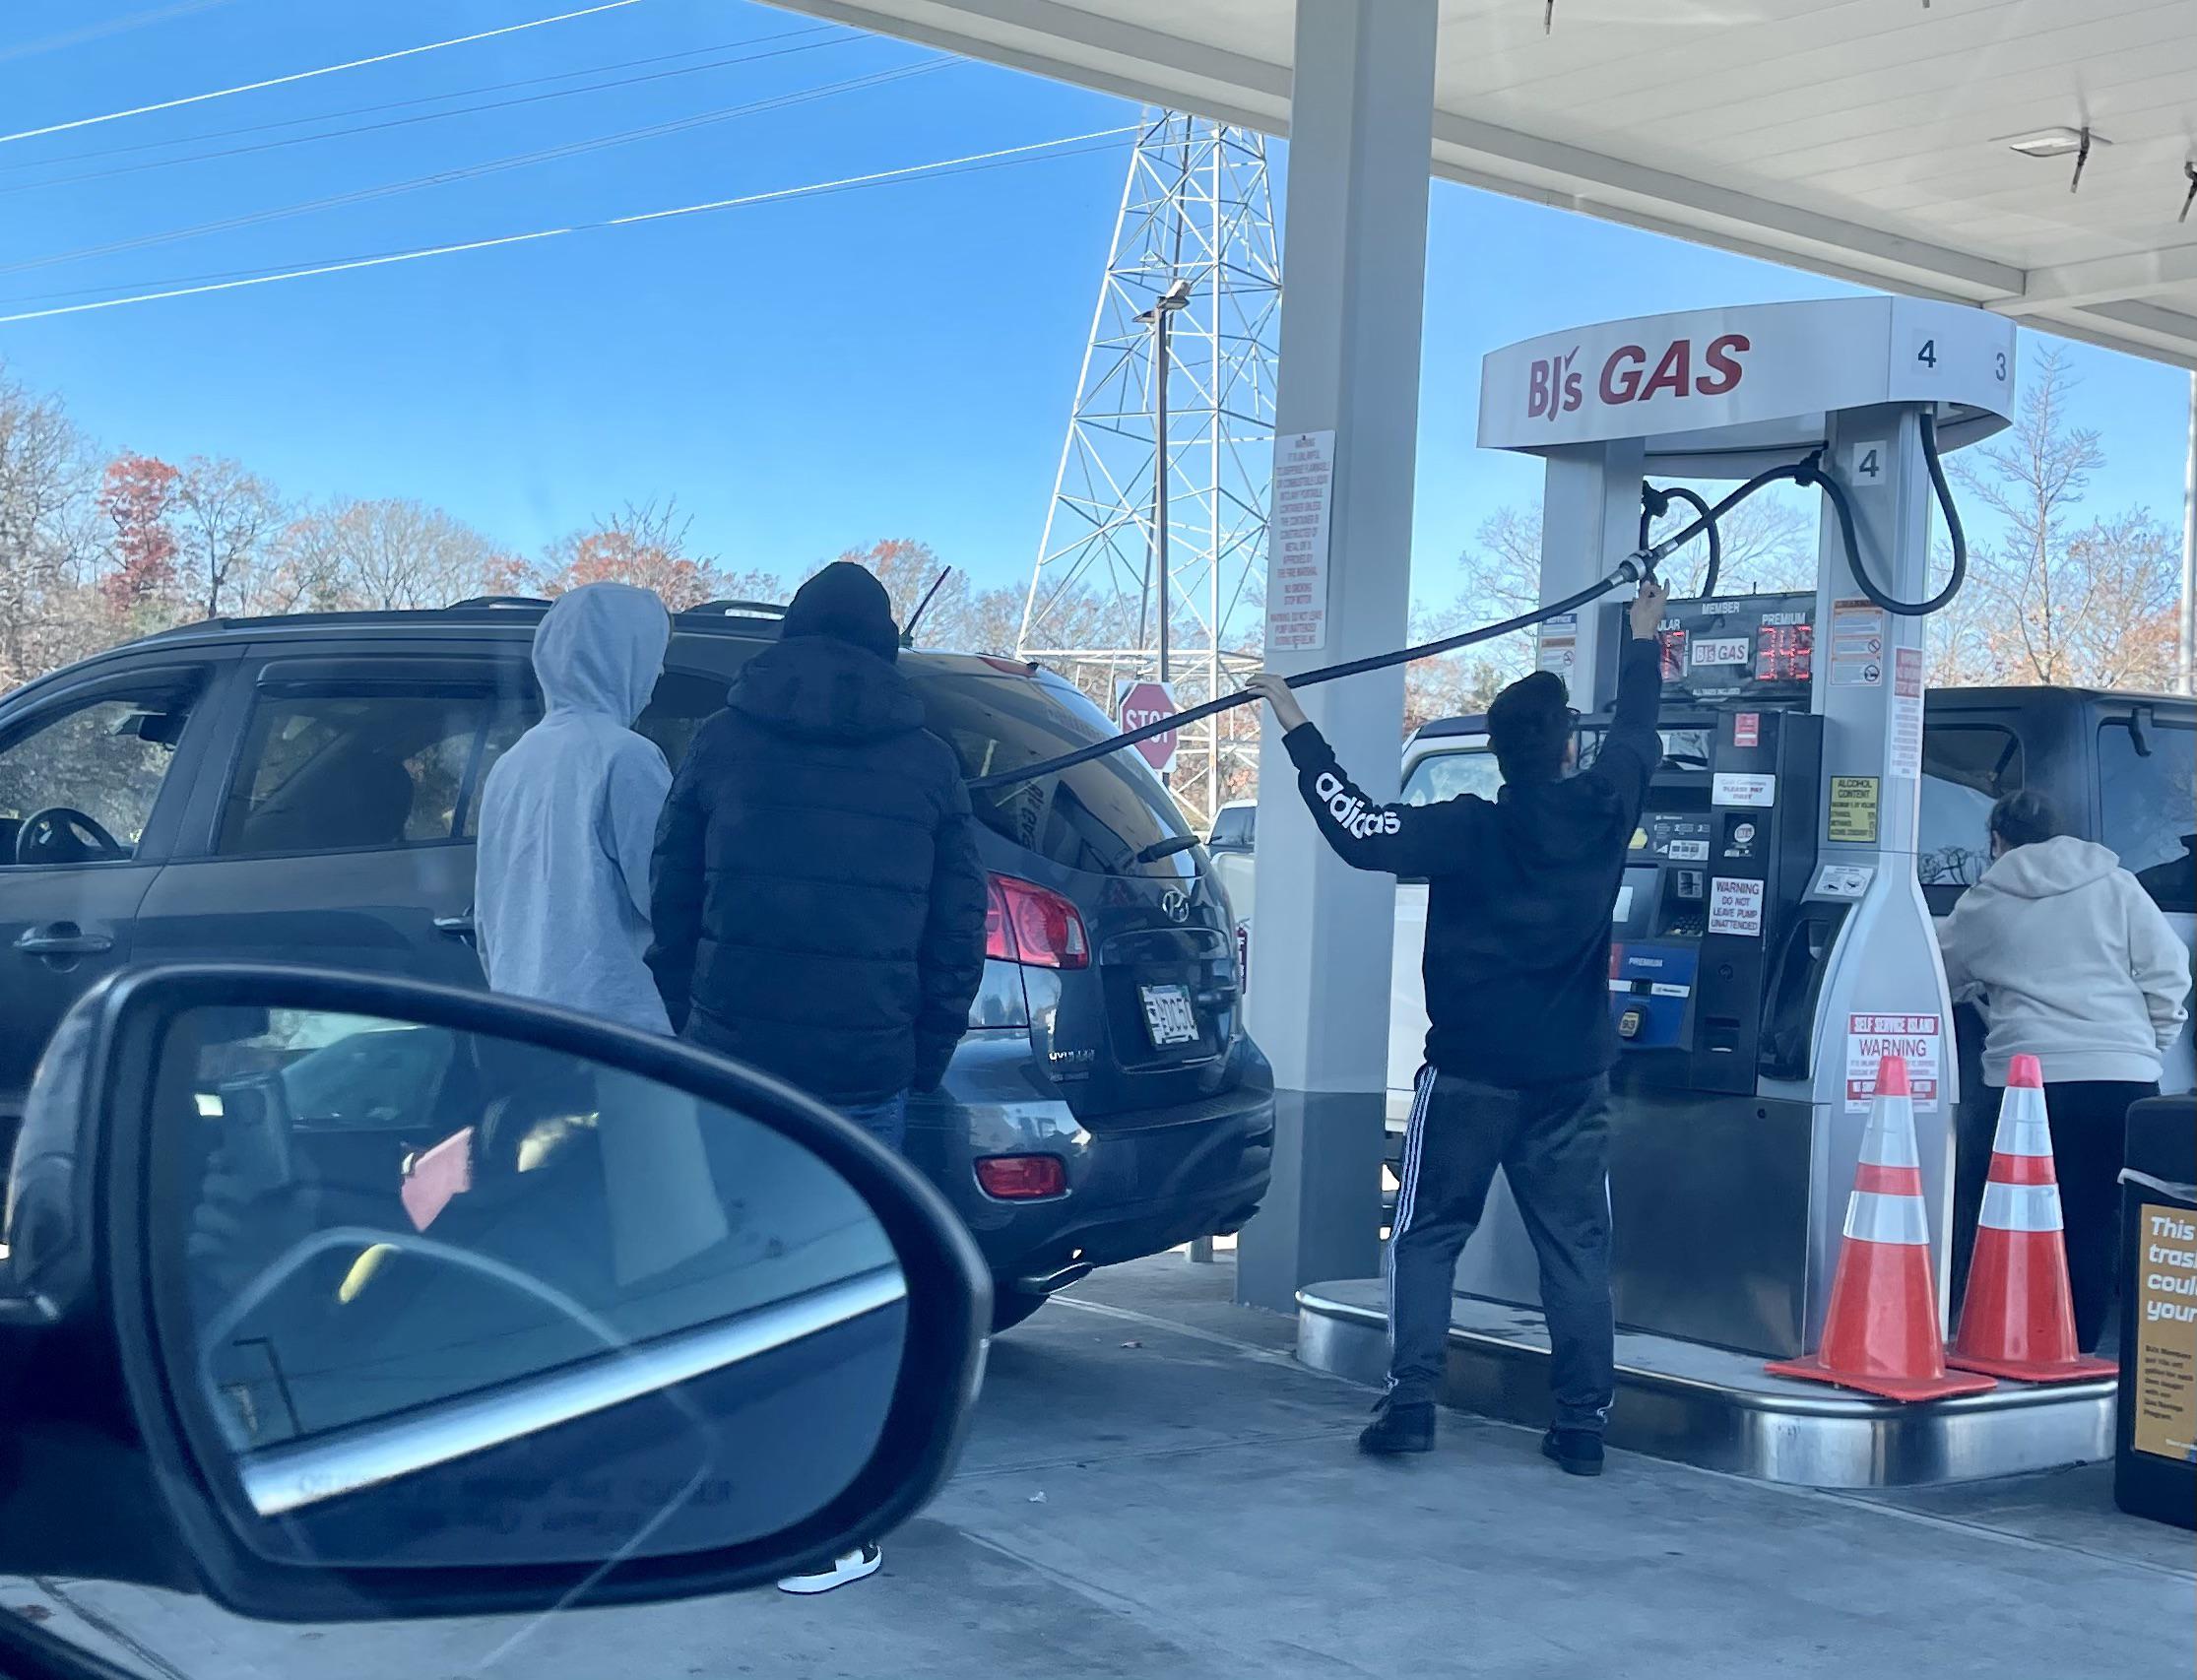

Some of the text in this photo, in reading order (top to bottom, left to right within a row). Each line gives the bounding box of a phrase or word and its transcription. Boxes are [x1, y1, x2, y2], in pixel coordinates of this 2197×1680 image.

[1918, 340, 1937, 368] 4
[1599, 334, 1751, 405] GAS
[1996, 353, 2007, 381] 3
[1859, 449, 1879, 478] 4
[1702, 602, 1741, 615] MEMBER
[1762, 613, 1806, 625] PREMIUM
[1718, 645, 1746, 661] GAS
[1126, 709, 1175, 743] STOP
[1838, 779, 1872, 789] ALCOHOL
[1838, 789, 1870, 799] CONTENT
[1316, 772, 1401, 839] adidas
[1716, 881, 1760, 895] WARNING
[1722, 896, 1751, 906] DO NOT
[1712, 907, 1758, 919] LEAVE PUMP
[1711, 919, 1758, 931] UNATTENDED
[1622, 1019, 1636, 1029] 93
[1854, 1016, 1935, 1033] SELF SERVICE ISLAND
[1859, 1039, 1926, 1057] WARNING
[2151, 1216, 2195, 1241] This
[2148, 1273, 2197, 1296] coul
[2147, 1300, 2197, 1323] your
